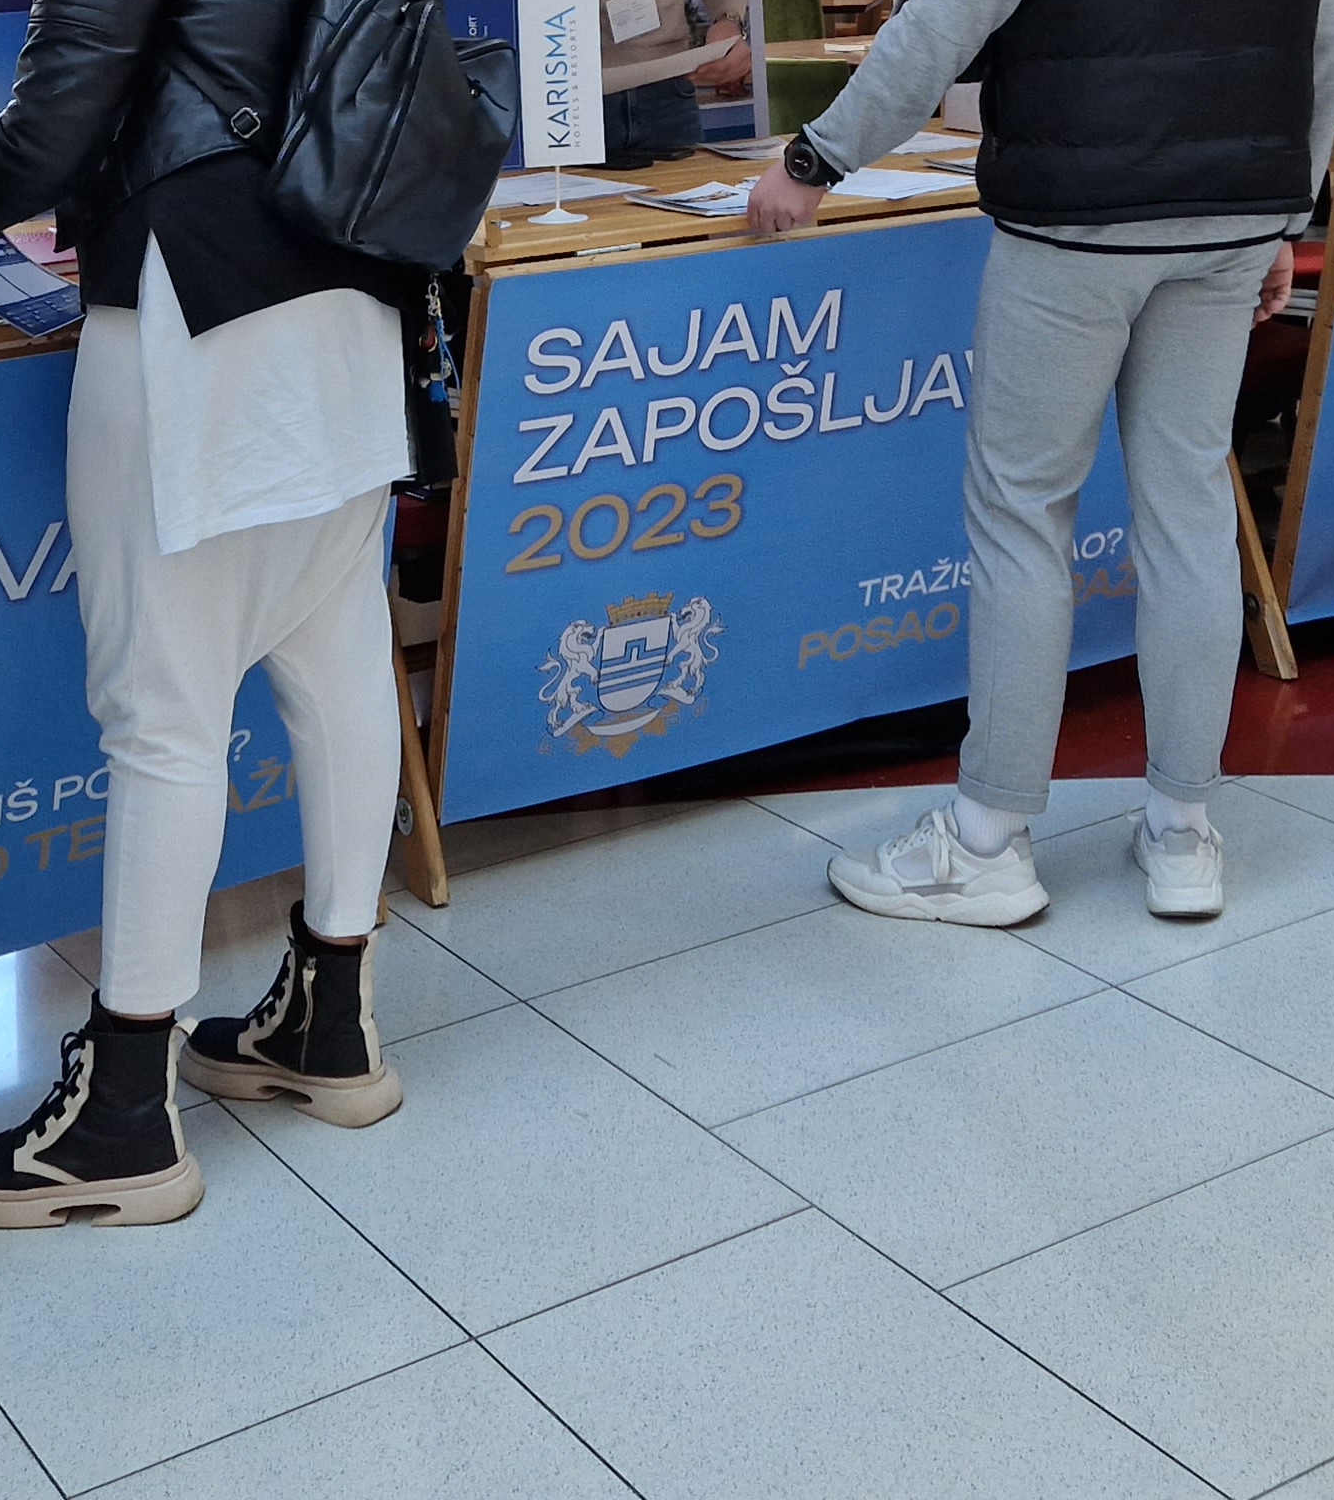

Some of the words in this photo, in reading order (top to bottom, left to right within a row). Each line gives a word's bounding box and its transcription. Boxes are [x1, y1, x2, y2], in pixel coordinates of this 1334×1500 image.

[544, 5, 576, 149] KARISMA
[570, 19, 579, 77] RESORTS
[572, 97, 581, 148] HOTELS
[523, 288, 844, 396] SAJAM
[512, 350, 974, 485] ZAPOŠLJA
[505, 472, 745, 575] 2023
[798, 602, 961, 671] POSAO
